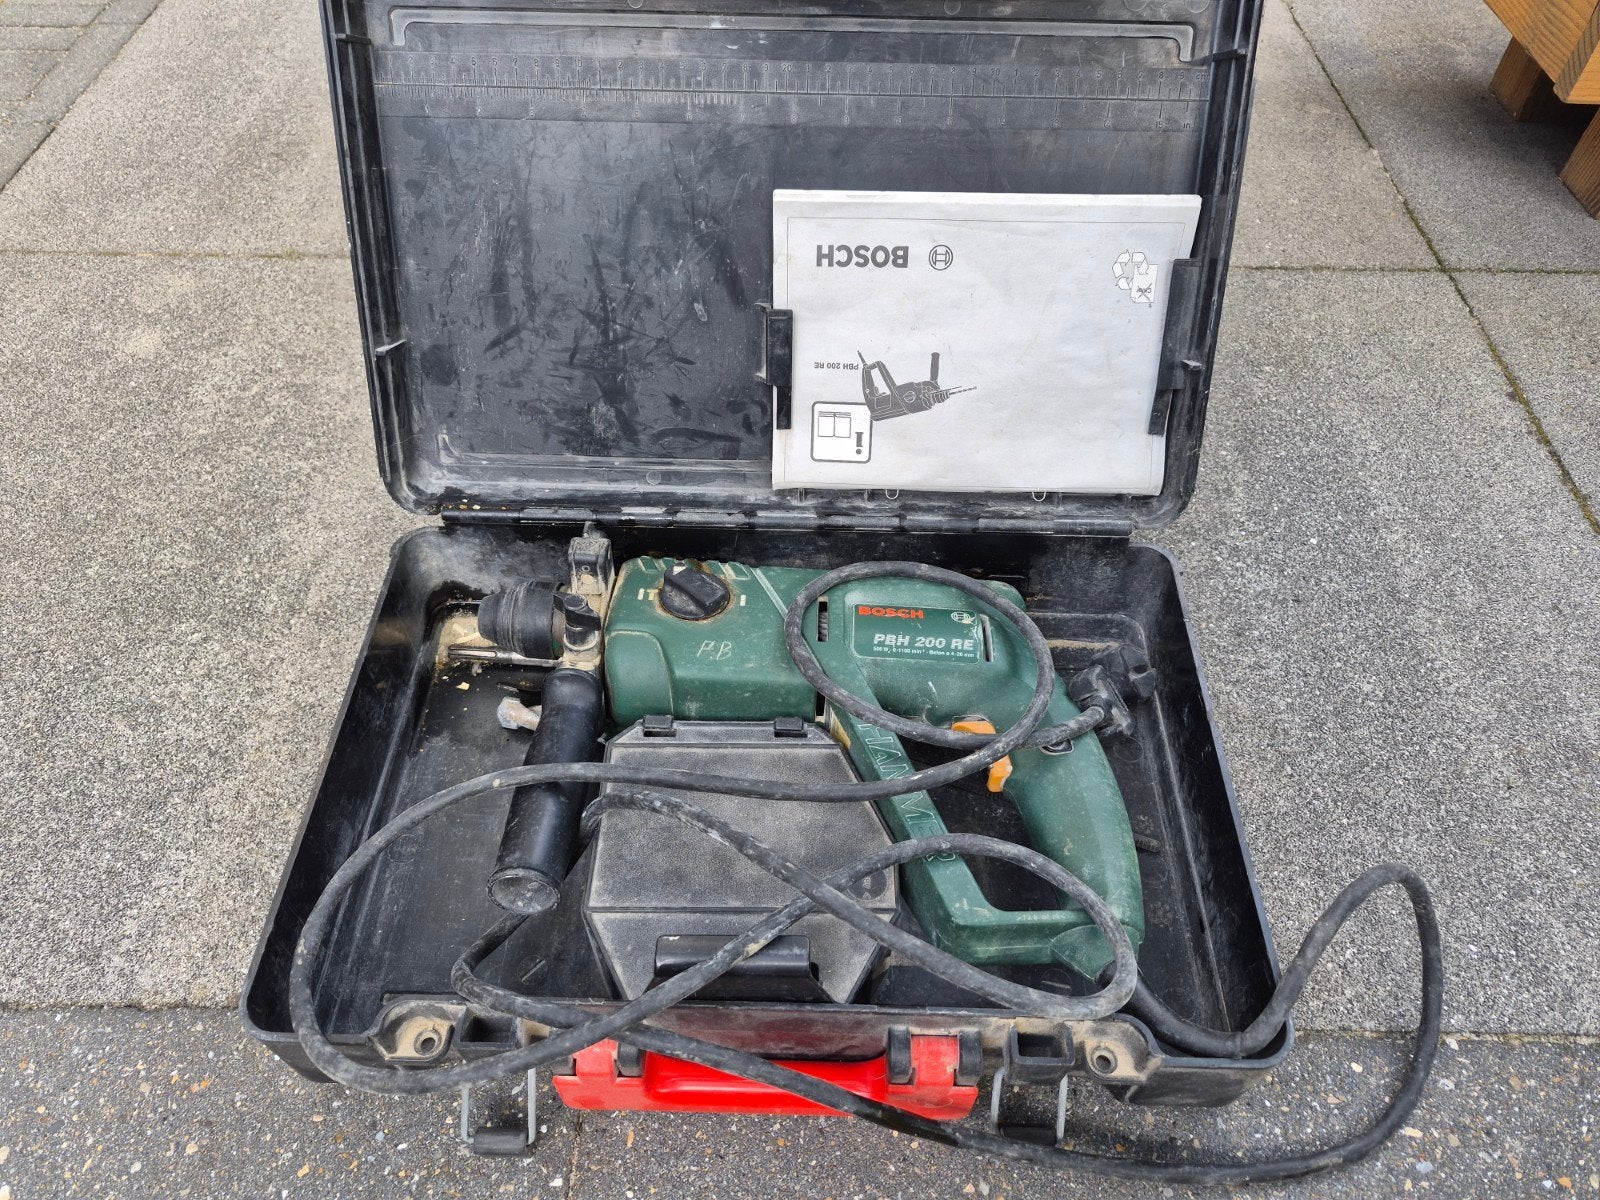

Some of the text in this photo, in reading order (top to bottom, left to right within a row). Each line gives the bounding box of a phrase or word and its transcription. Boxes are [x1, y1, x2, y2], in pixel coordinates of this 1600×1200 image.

[816, 244, 910, 269] BOSCH
[814, 361, 859, 371] PBH 200 RE
[858, 606, 924, 619] BOSCH
[873, 633, 975, 651] PBH 200 RE
